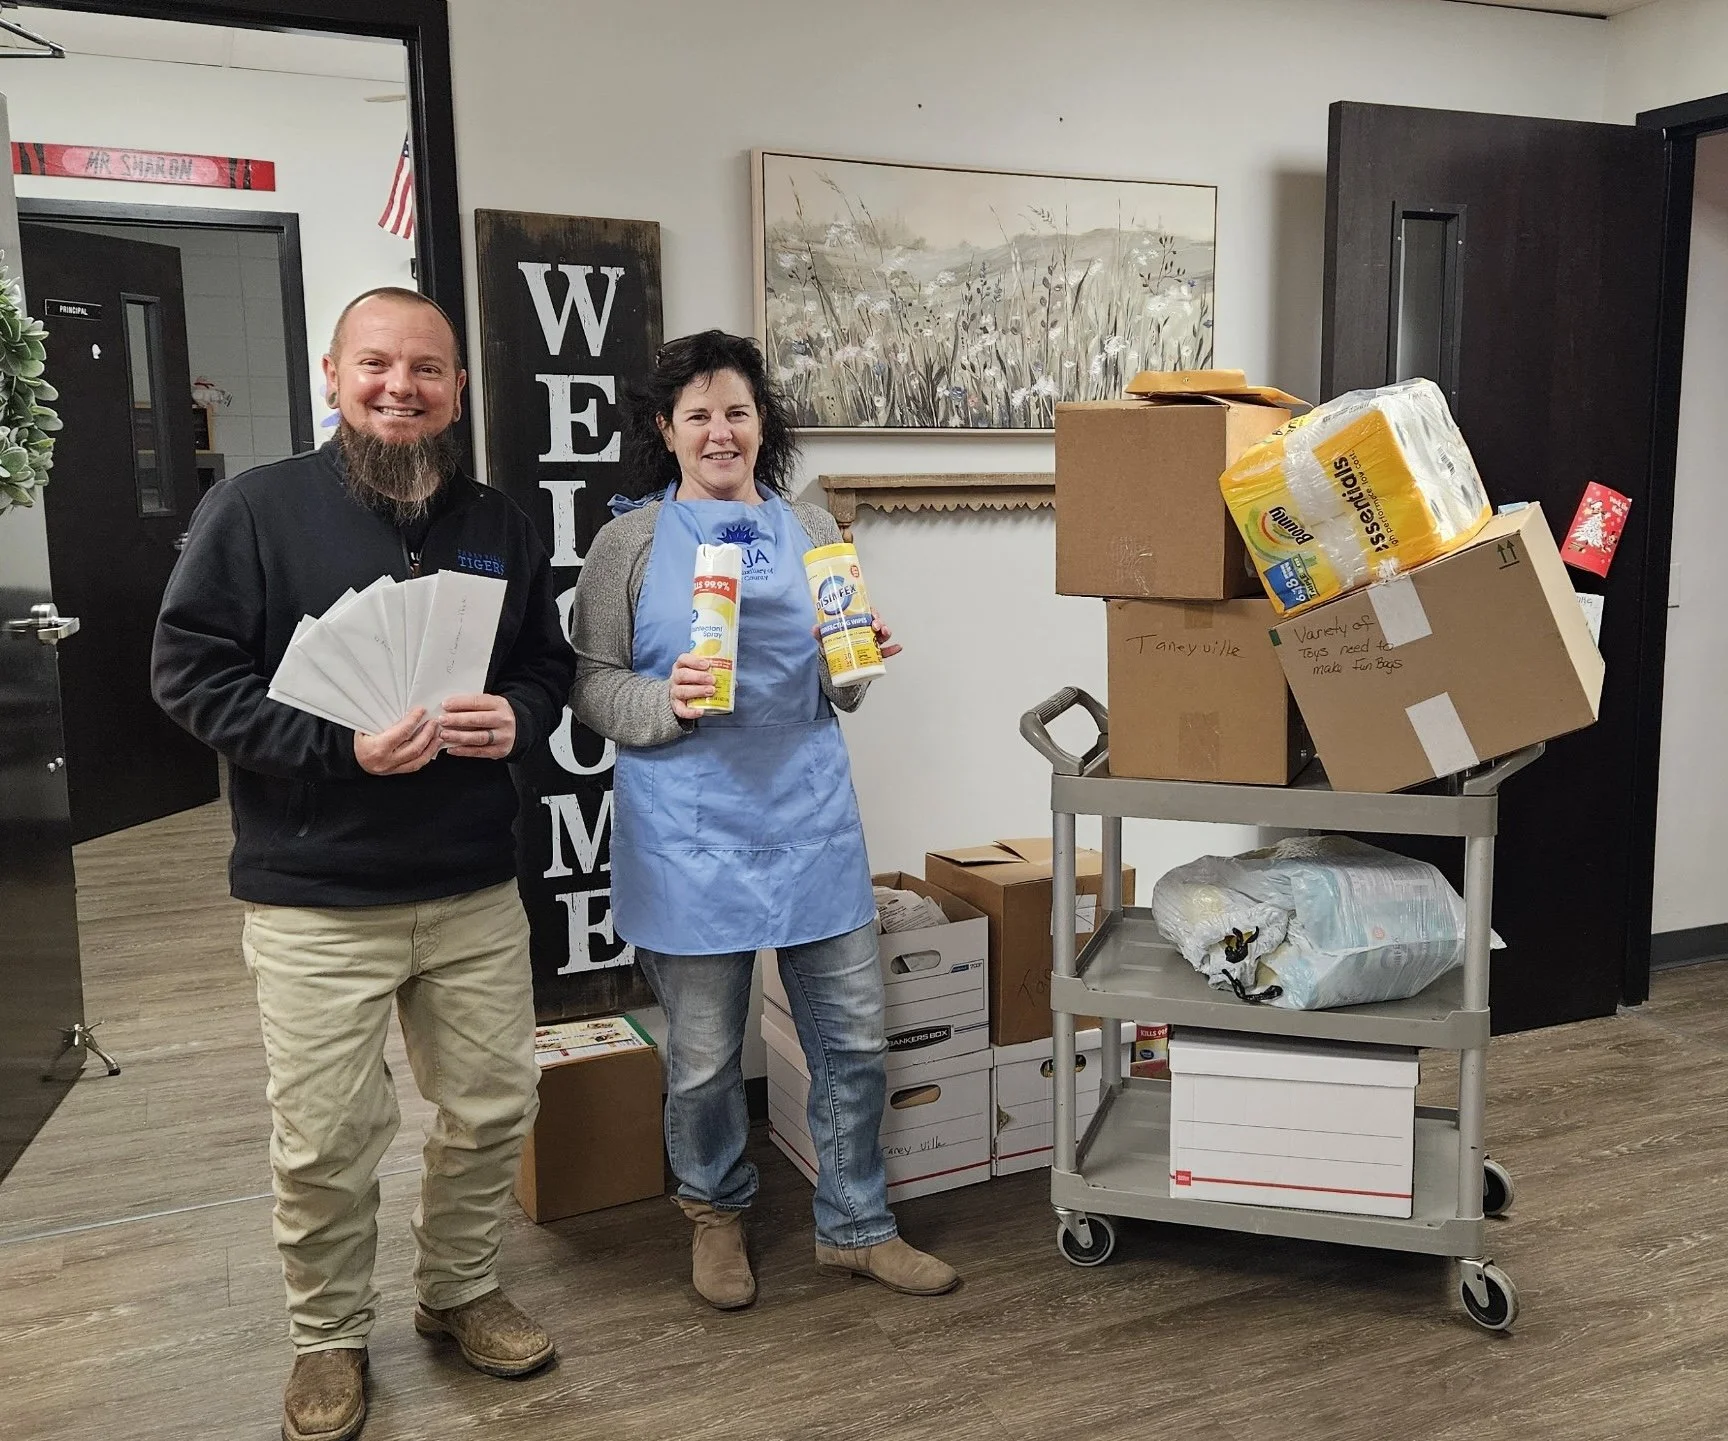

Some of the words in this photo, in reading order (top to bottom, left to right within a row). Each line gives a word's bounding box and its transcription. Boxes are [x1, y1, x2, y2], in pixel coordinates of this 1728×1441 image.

[120, 153, 193, 180] SHARON
[59, 305, 89, 316] PRINCIPAL
[1268, 506, 1314, 546] Bounty
[457, 555, 505, 576] TIGERS
[704, 580, 730, 592] 99.9%
[703, 631, 723, 639] Spray
[1294, 616, 1347, 644] Variety
[1352, 615, 1375, 631] of
[1298, 647, 1329, 662] Toys
[1340, 638, 1370, 655] need
[1376, 640, 1394, 652] to
[1313, 660, 1343, 675] make
[1375, 656, 1403, 675] Bags
[929, 1029, 948, 1040] BOX
[1140, 1029, 1157, 1037] KILLS
